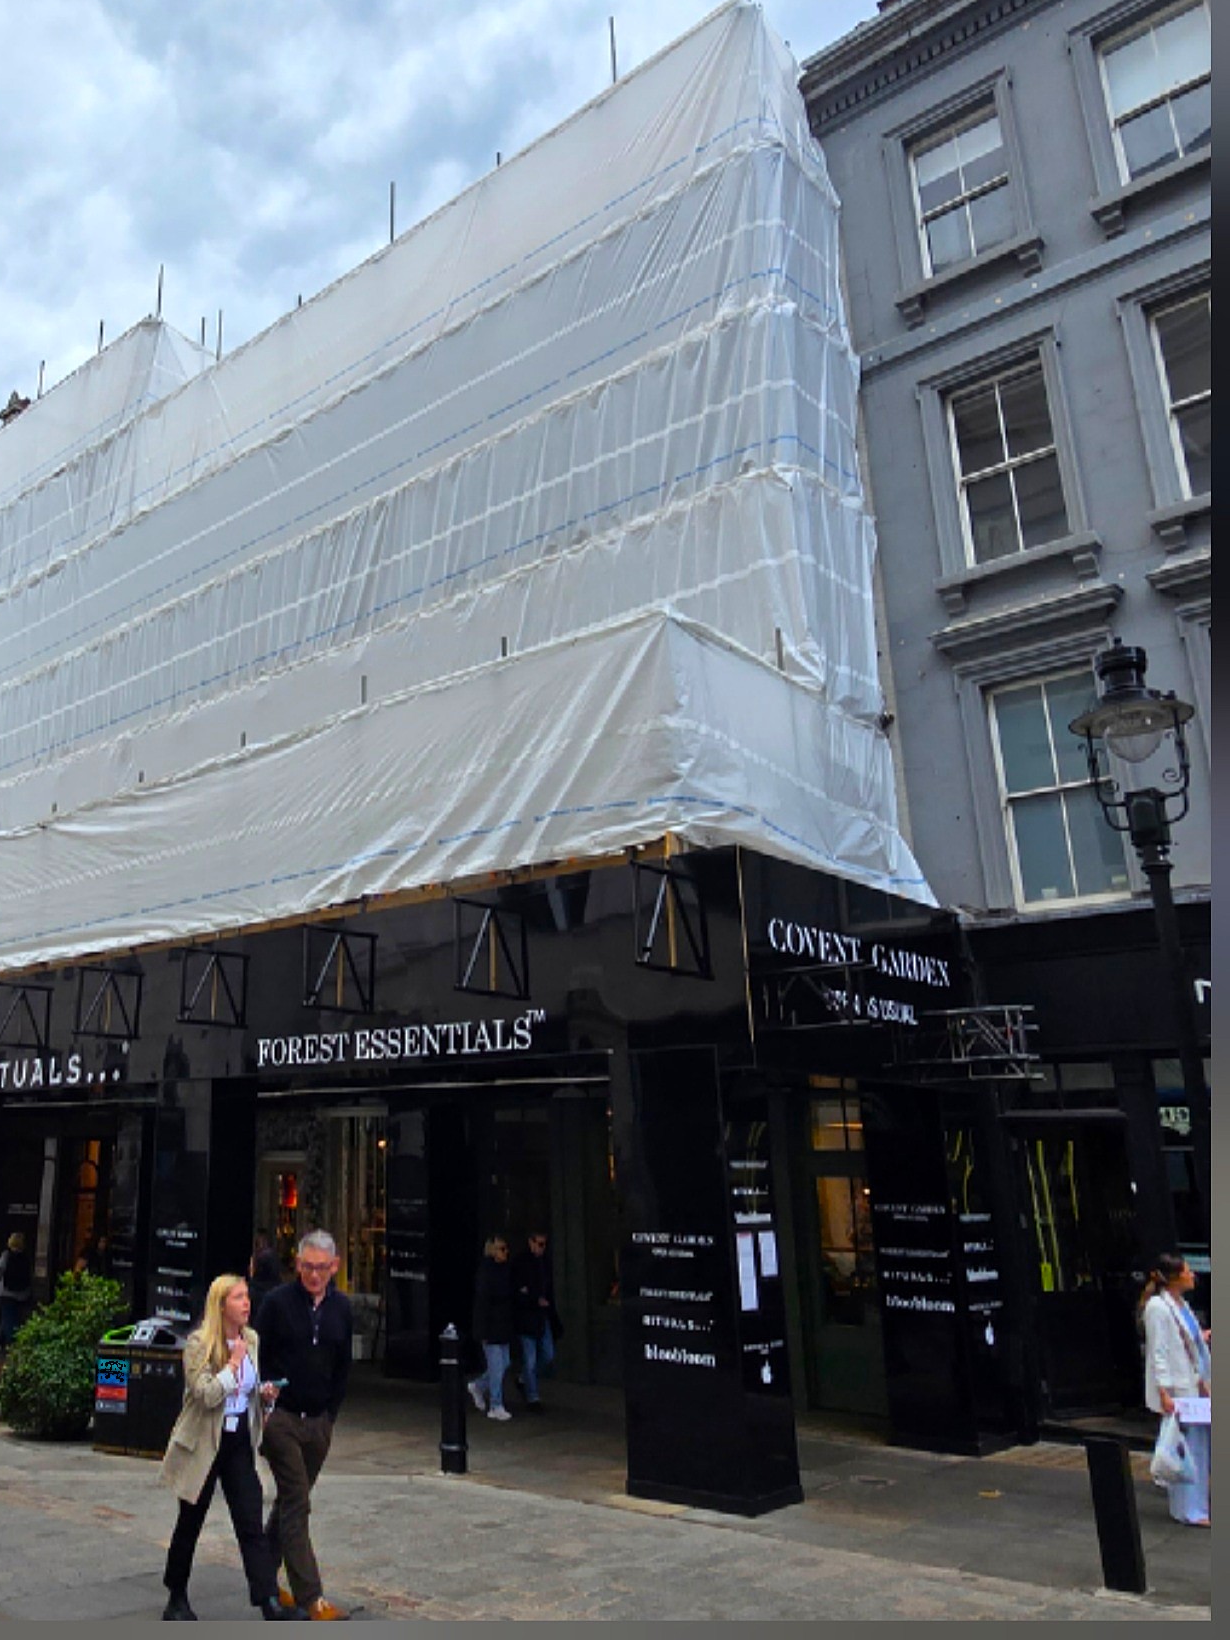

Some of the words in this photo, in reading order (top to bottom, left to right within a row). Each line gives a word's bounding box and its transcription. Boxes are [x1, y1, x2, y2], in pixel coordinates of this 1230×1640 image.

[768, 917, 862, 963] COVENT
[872, 944, 950, 987] GARDEN
[257, 1032, 350, 1067] FOREST
